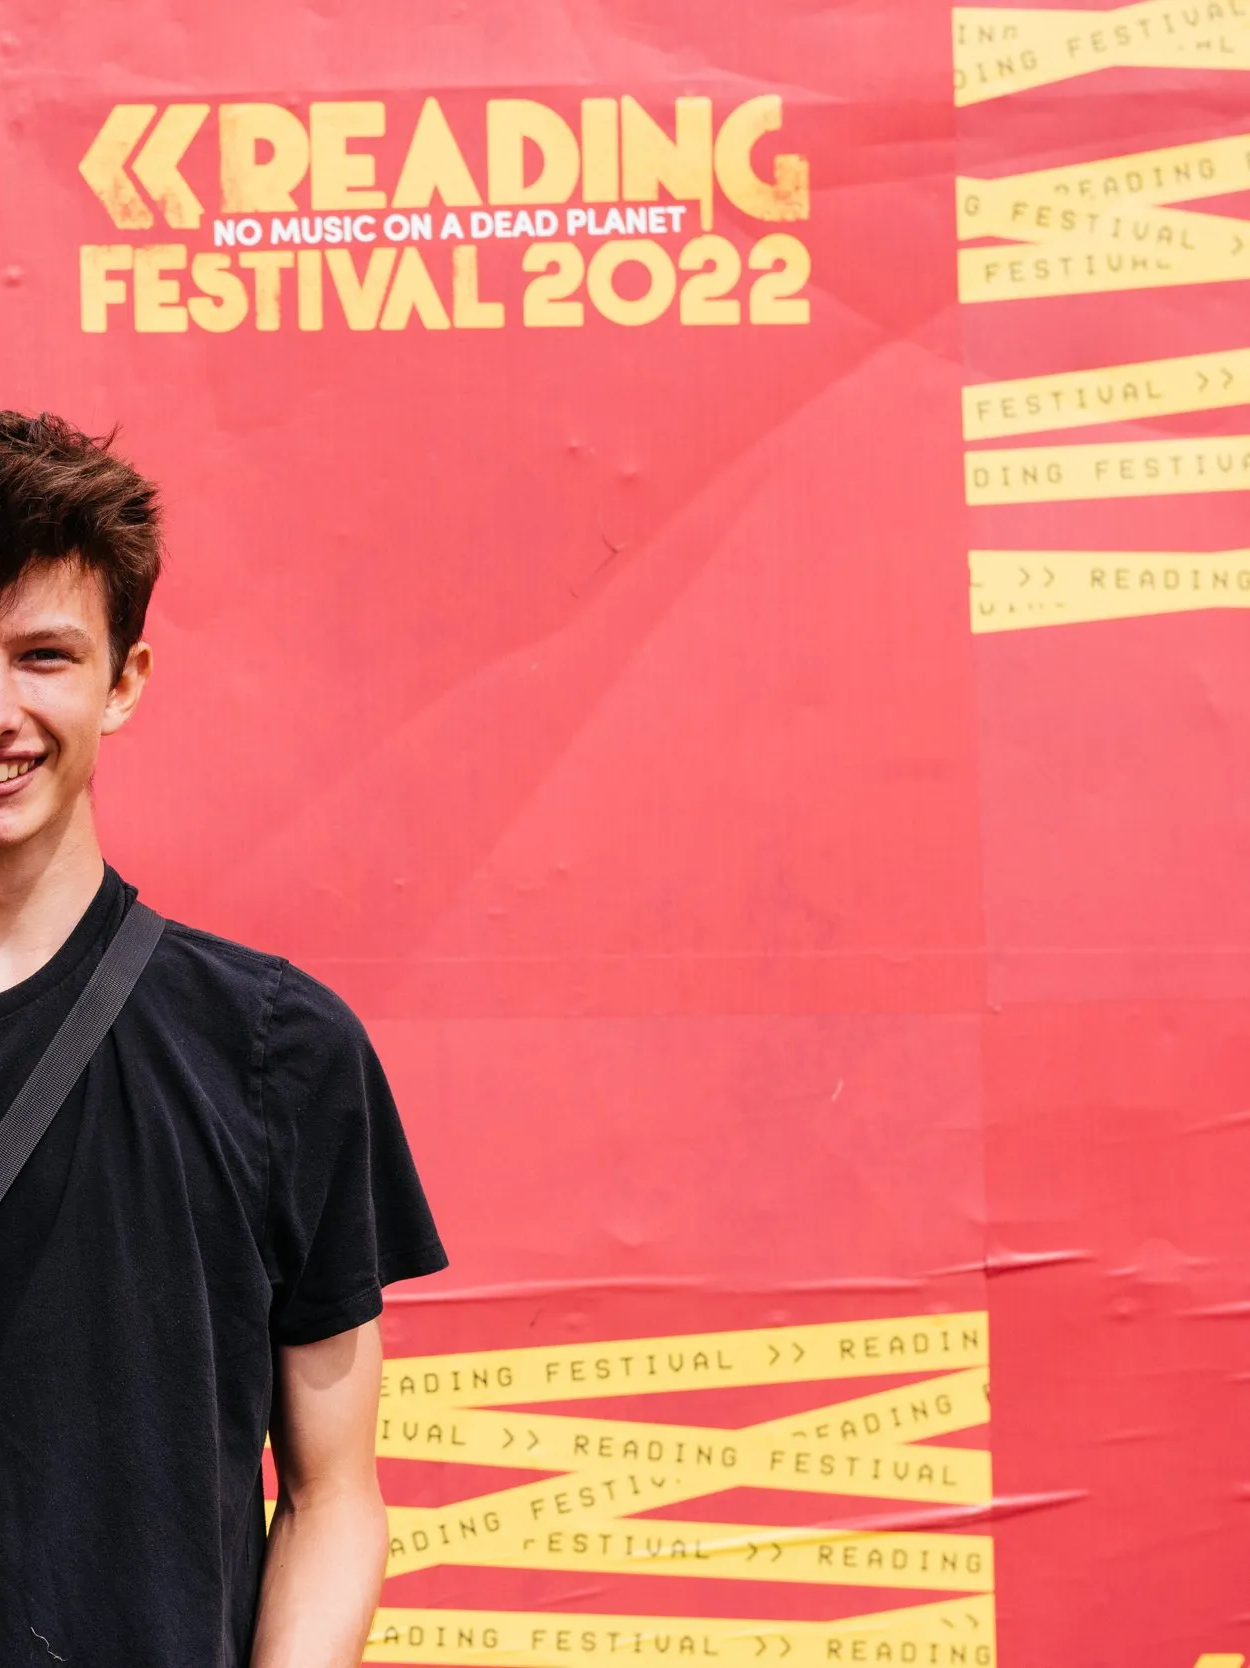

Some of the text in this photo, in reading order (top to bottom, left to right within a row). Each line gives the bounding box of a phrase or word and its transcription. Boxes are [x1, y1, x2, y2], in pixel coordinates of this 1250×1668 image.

[1066, 0, 1247, 58] FESTIVAL
[219, 95, 810, 231] READING
[213, 205, 687, 247] NO MUSIC ON A DEAD PLANET
[1011, 202, 1196, 250] FESTIVAL
[79, 235, 812, 333] FESTIVAL 2022
[976, 380, 1164, 421] FESTIVAL
[1091, 569, 1249, 590] READING
[546, 1350, 733, 1383] FESTIVAL
[574, 1435, 736, 1467] READING
[770, 1450, 956, 1486] FESTIVAL
[818, 1544, 981, 1573] READING
[532, 1629, 718, 1656] FESTIVAL
[826, 1638, 992, 1667] READING
